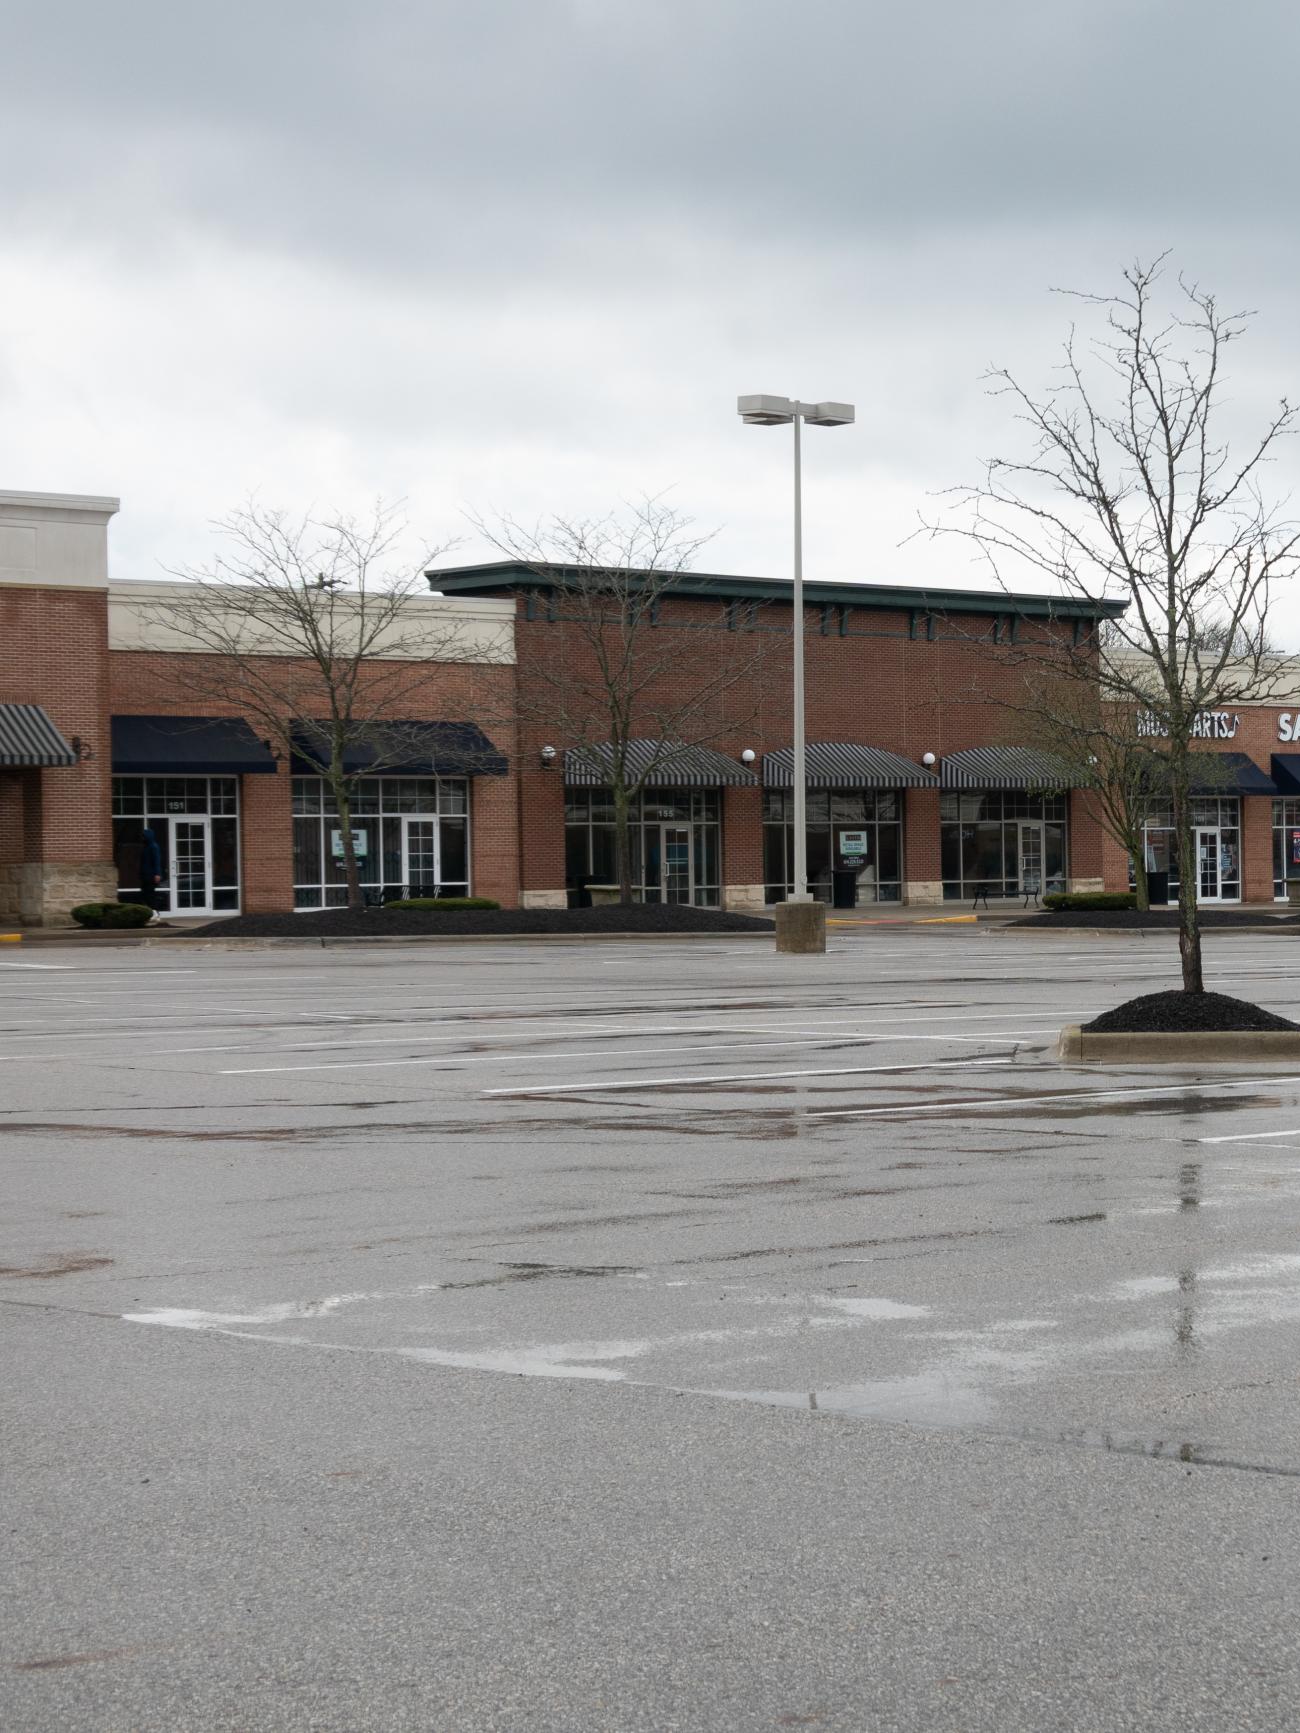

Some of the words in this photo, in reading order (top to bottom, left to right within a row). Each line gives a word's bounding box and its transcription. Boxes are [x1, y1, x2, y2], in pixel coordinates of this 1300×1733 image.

[1192, 711, 1230, 738] ARTS
[168, 801, 185, 810] 151
[658, 810, 674, 818] 155
